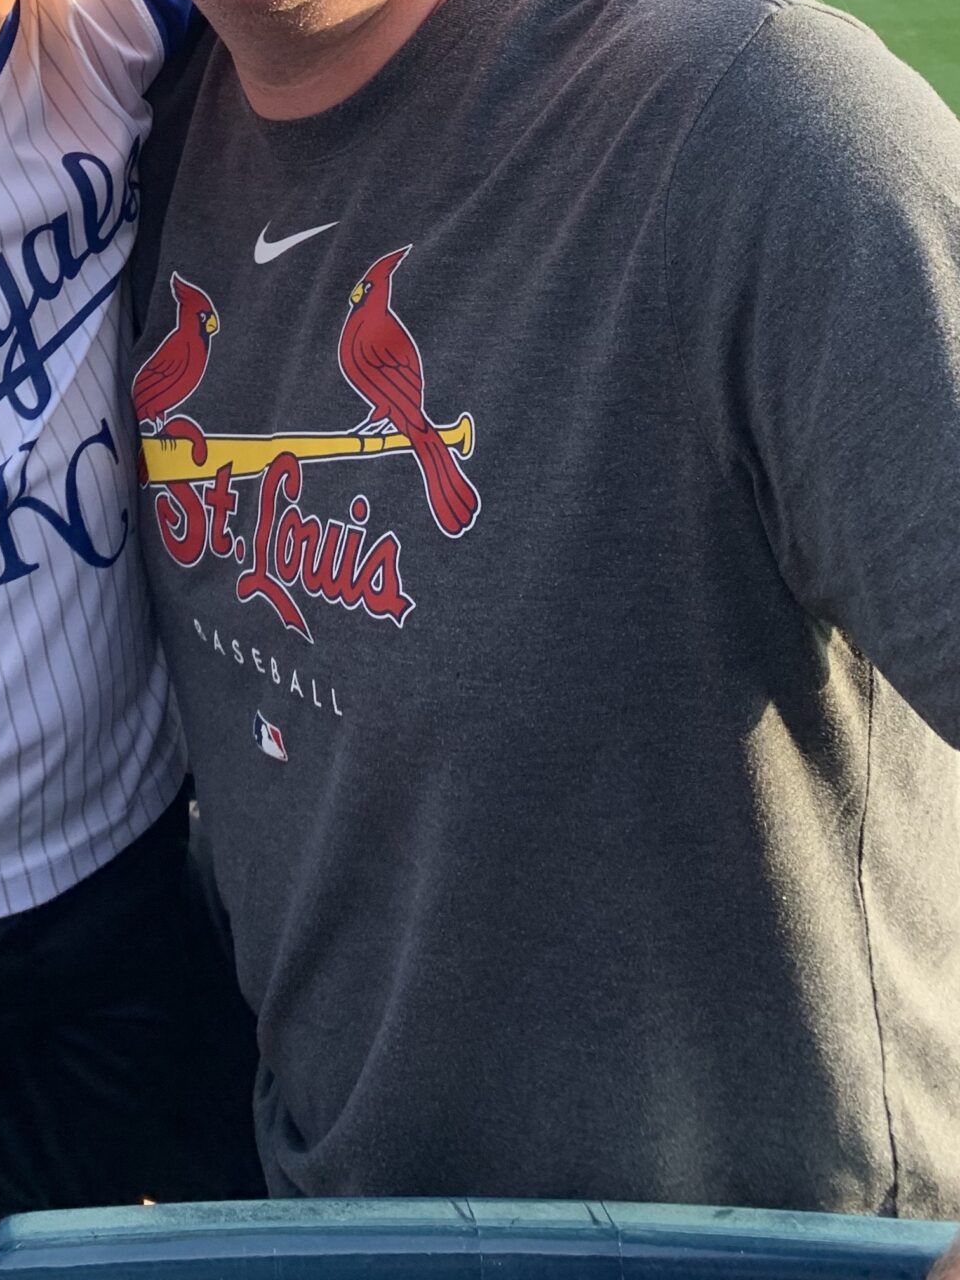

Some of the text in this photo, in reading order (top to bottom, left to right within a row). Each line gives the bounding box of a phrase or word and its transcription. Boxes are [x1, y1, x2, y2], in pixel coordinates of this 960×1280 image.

[155, 414, 416, 644] St. Louis
[193, 618, 343, 716] BASEBALL
